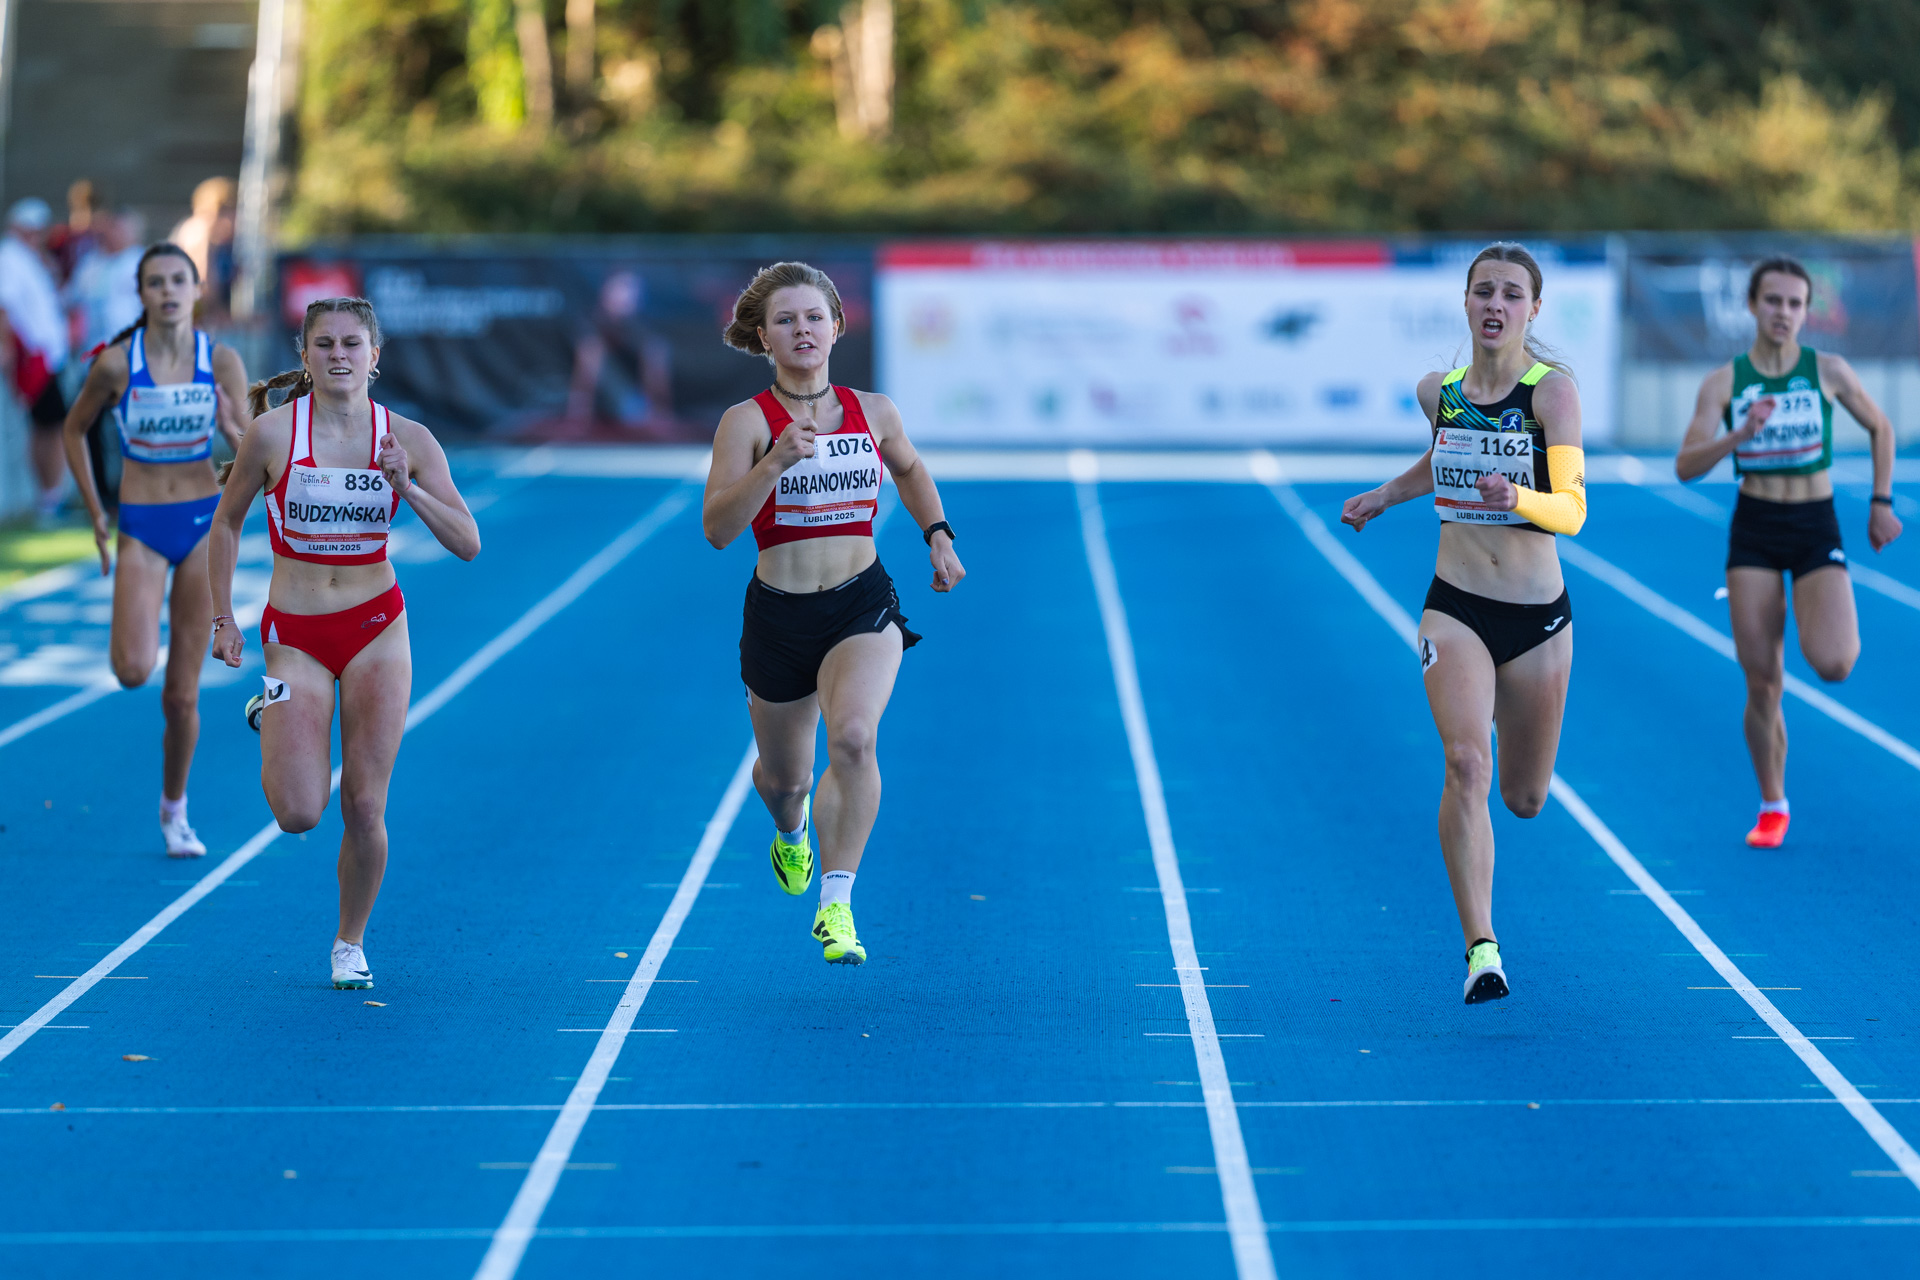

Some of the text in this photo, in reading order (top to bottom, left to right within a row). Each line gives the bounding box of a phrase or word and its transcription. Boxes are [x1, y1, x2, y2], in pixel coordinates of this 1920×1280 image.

[173, 388, 212, 406] 1202
[138, 415, 205, 435] JAGUSZ
[826, 438, 873, 457] 1076
[1480, 437, 1530, 456] 1162
[344, 473, 383, 491] 836
[780, 468, 878, 495] BARANOWSKA
[1435, 466, 1532, 490] LESZCZKA
[288, 501, 387, 523] BUDZYŃSKA
[803, 511, 855, 523] LUBLIN 2025
[1456, 511, 1509, 521] LUBLIN 2025
[1421, 638, 1433, 668] 4
